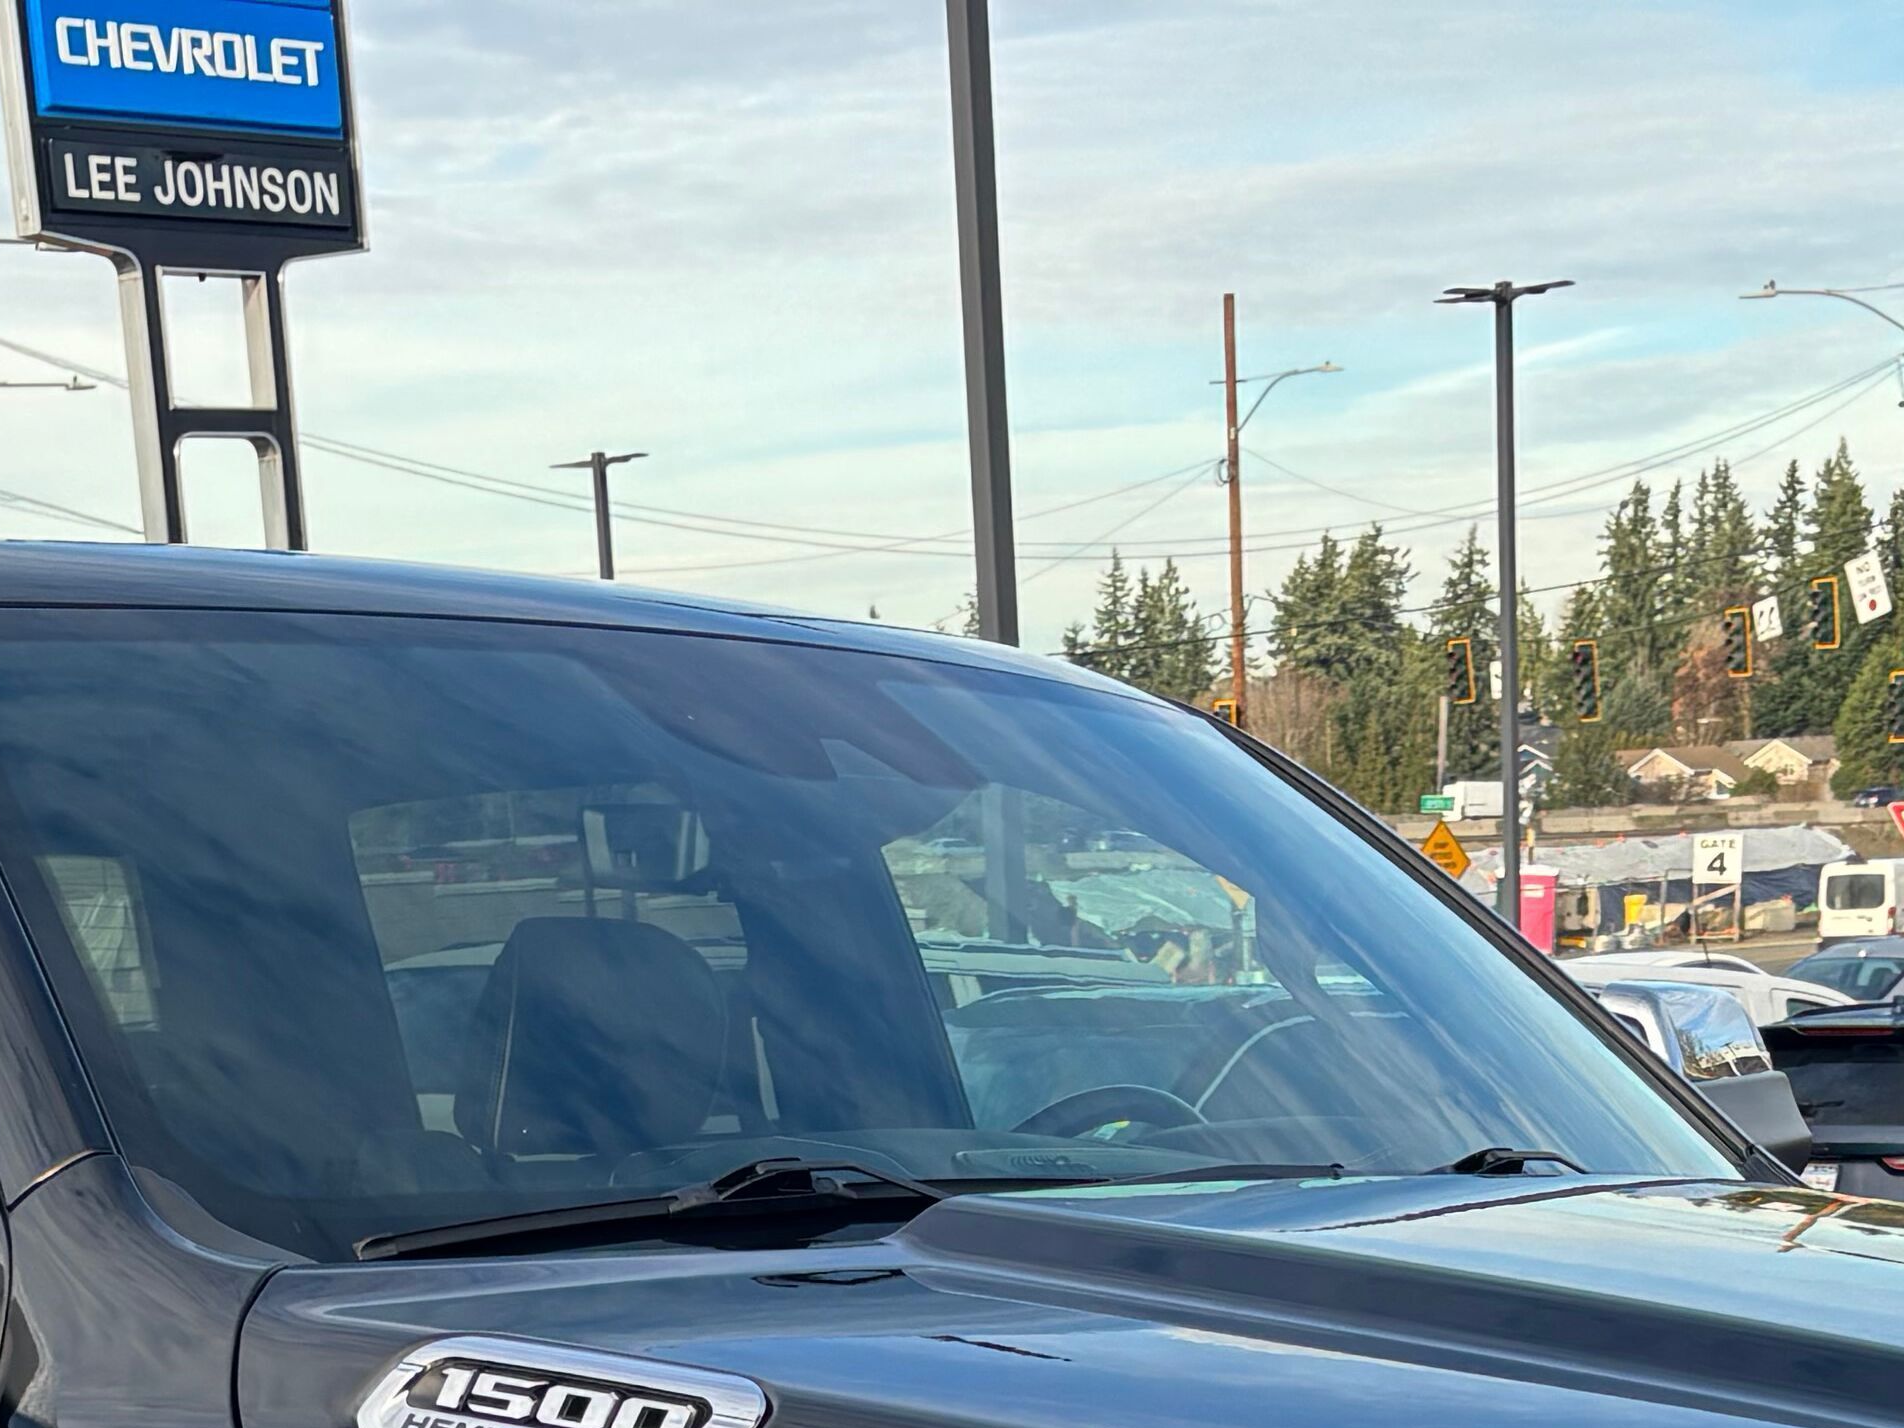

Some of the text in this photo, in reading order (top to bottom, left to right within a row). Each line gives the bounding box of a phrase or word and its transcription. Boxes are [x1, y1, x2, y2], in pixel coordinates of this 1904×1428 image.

[55, 16, 325, 87] CHEVROLET
[63, 152, 340, 216] LEE JOHNSON
[1700, 838, 1737, 849] GATE
[1706, 851, 1727, 876] 4
